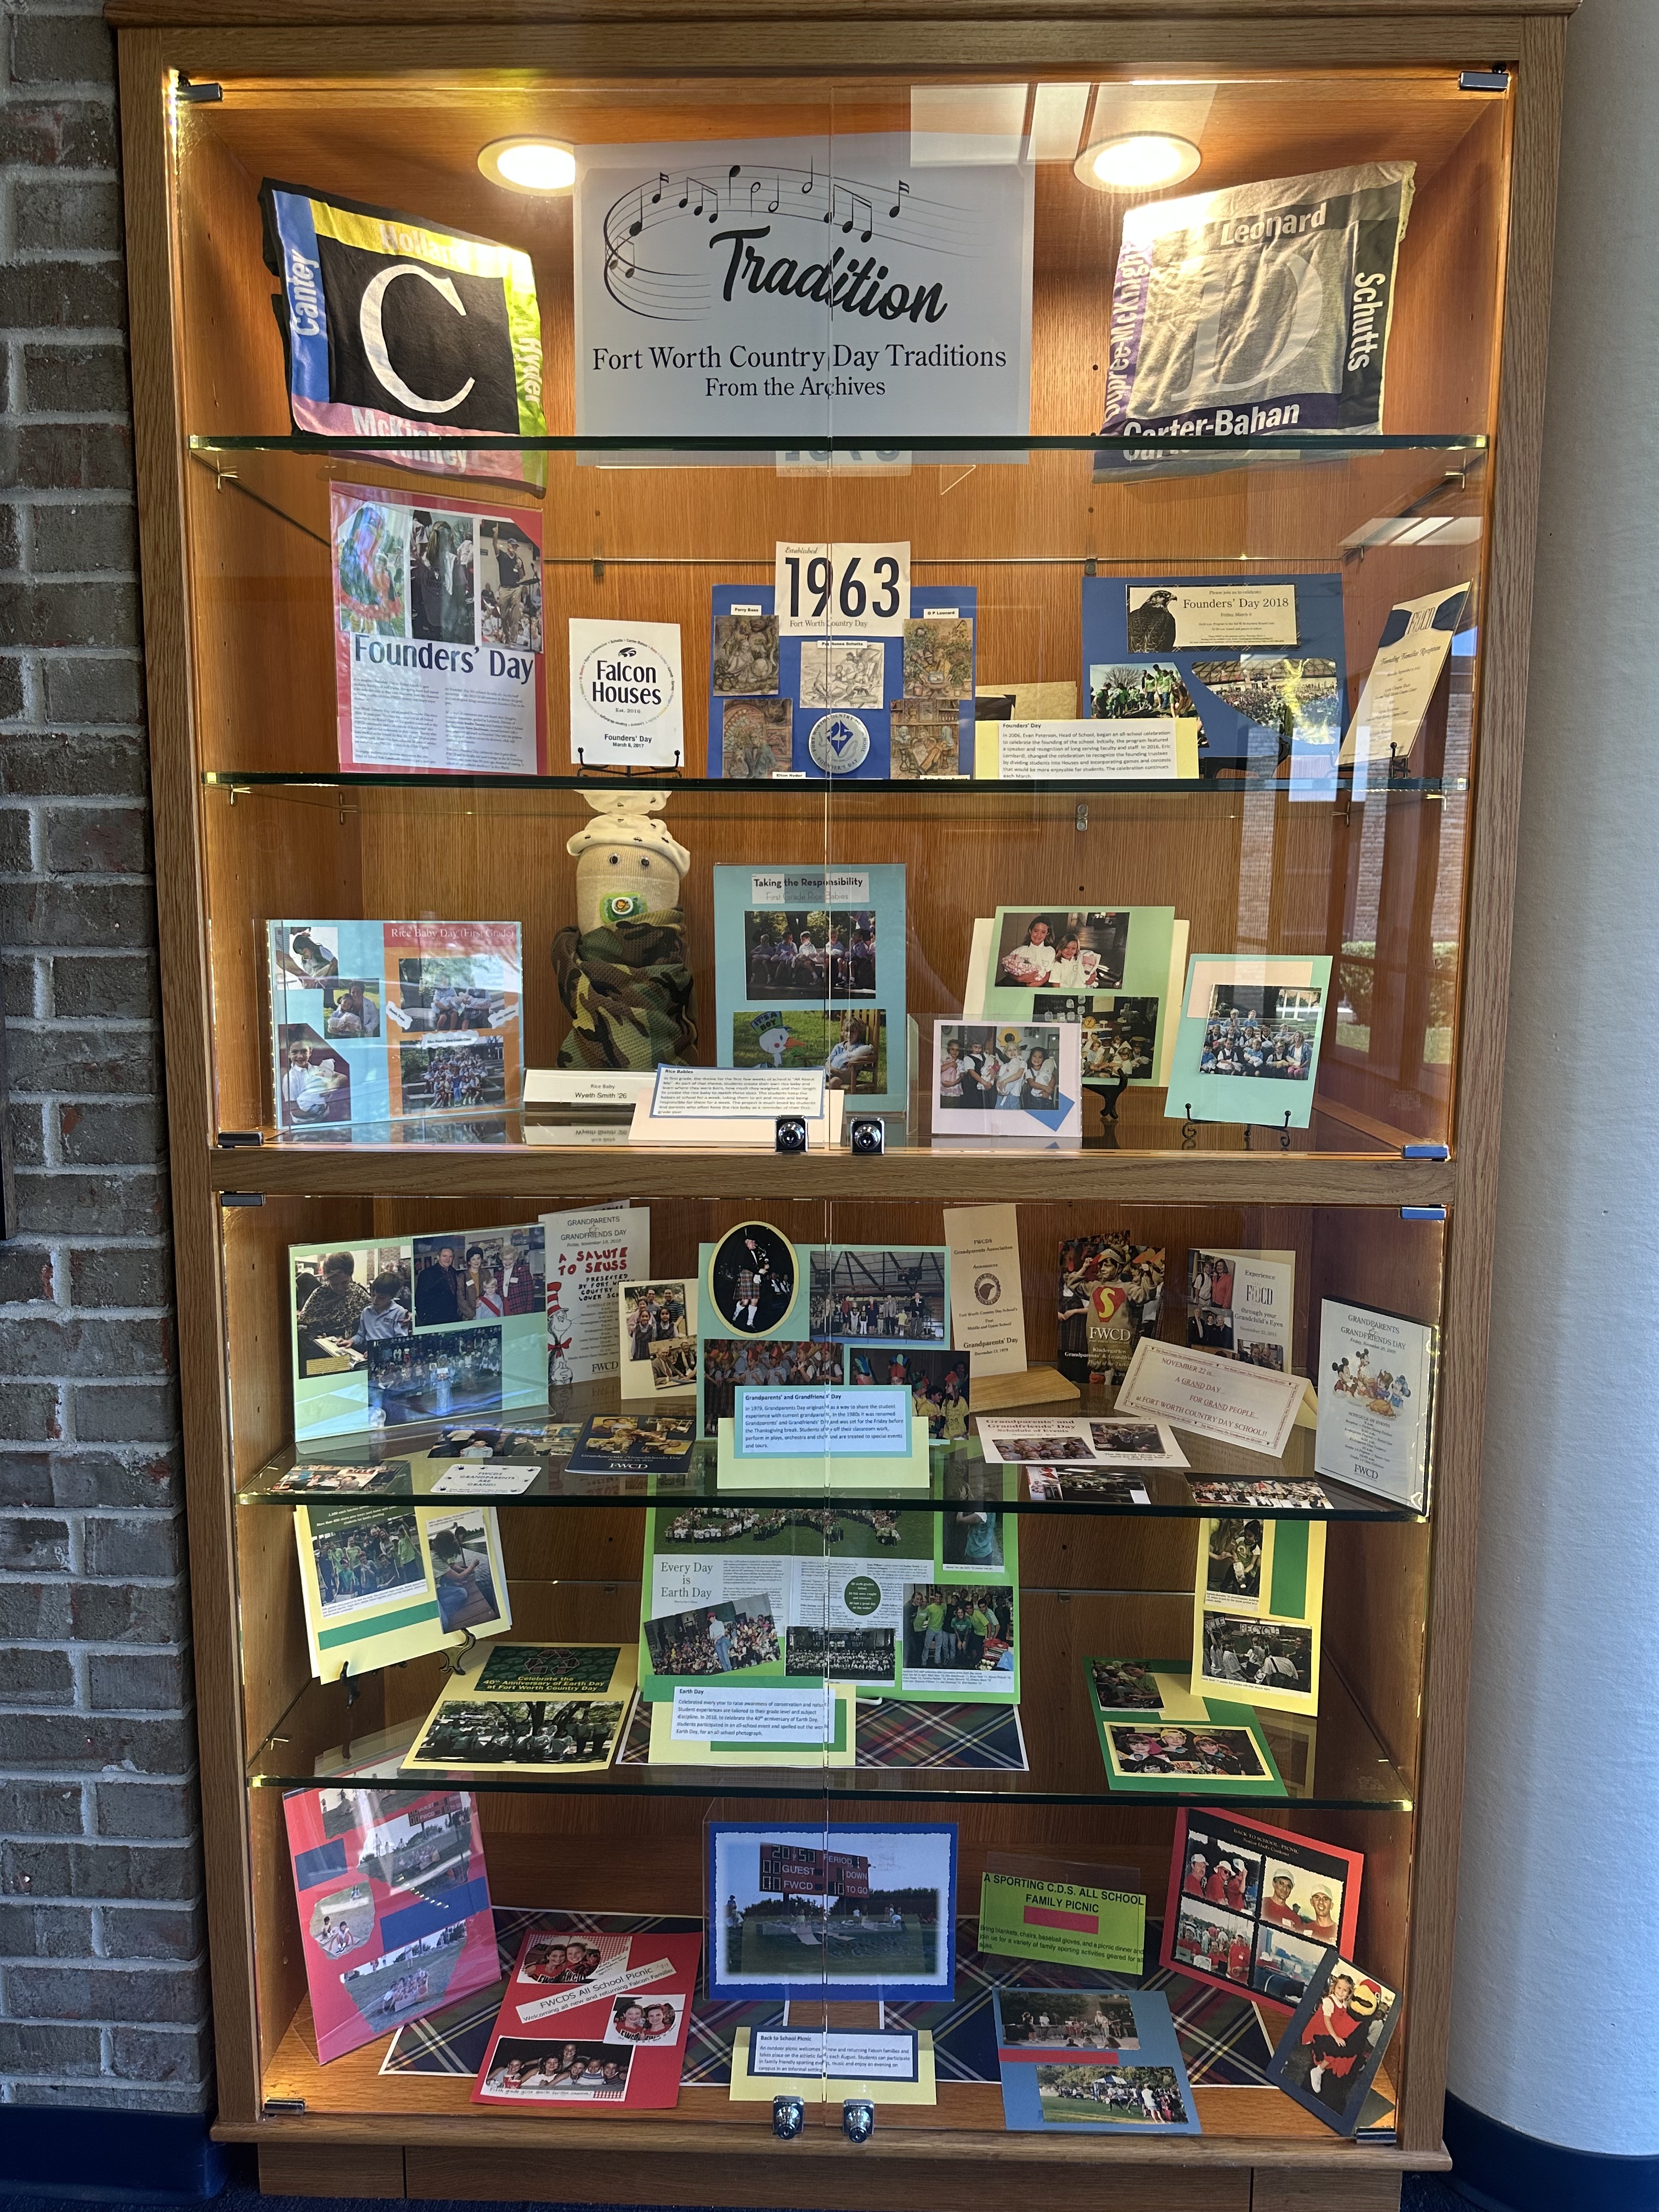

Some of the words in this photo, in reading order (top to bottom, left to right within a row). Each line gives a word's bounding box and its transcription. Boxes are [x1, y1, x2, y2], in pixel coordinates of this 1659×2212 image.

[1220, 203, 1327, 246] Leonard
[709, 225, 947, 323] Tradition
[292, 249, 319, 336] Cantey
[1347, 272, 1386, 371] Schutts
[360, 264, 475, 413] C
[593, 348, 643, 370] Fort
[648, 345, 721, 369] Worth
[730, 345, 826, 371] Country
[833, 345, 880, 371] Day
[885, 343, 1006, 367] Traditions
[706, 377, 758, 396] From
[764, 377, 794, 396] the
[799, 376, 885, 396] Archives
[1123, 403, 1300, 437] Carter-Bahan
[785, 556, 900, 617] 1963
[1183, 599, 1235, 608] Founders'
[1239, 599, 1260, 609] Day
[1263, 598, 1289, 607] 2018
[355, 634, 479, 673] Founders'
[490, 650, 533, 685] Day
[597, 660, 656, 683] Falcon
[592, 681, 662, 705] Houses
[754, 879, 782, 888] Taking
[802, 877, 863, 887] Responsibility
[766, 892, 781, 900] First
[783, 891, 805, 900] Grade
[808, 891, 822, 900] Rice
[825, 891, 848, 900] Babies
[391, 929, 411, 938] Rice
[415, 928, 437, 940] Baby
[440, 929, 458, 940] Day
[460, 928, 482, 939] (First
[486, 928, 514, 938] Grade)
[567, 1216, 620, 1226] GRANDPARENTS
[561, 1231, 612, 1240] GRANDFRIENDS
[559, 1254, 567, 1263] A
[576, 1247, 628, 1262] SALUTE
[558, 1264, 577, 1276] TO
[585, 1260, 627, 1273] SEUSS
[1245, 1269, 1275, 1280] Experience
[586, 1273, 628, 1282] PRESENTED
[581, 1287, 612, 1295] COUNTRY
[1348, 1314, 1400, 1334] GRANDPARENTS
[1089, 1327, 1131, 1341] FWCD
[1341, 1327, 1392, 1346] GRANDFRIENDS
[1393, 1340, 1406, 1350] DAY
[963, 1338, 1005, 1348] Grandparents'
[592, 1361, 618, 1372] FWCD
[1161, 1358, 1198, 1373] NOVEMBER
[1181, 1378, 1205, 1390] GRAND
[1189, 1395, 1203, 1404] FOR
[1204, 1399, 1228, 1411] GRAND
[1142, 1397, 1159, 1406] FORT
[1160, 1402, 1184, 1414] WORTH
[1184, 1408, 1217, 1423] COUNTRY
[1218, 1418, 1234, 1428] DAY
[1234, 1423, 1267, 1437] SCHOOL!!
[1355, 1464, 1378, 1479] FWCD
[661, 1562, 690, 1573] Every
[693, 1562, 713, 1573] Day
[682, 1575, 691, 1584] is
[661, 1588, 688, 1598] Earth
[692, 1588, 712, 1599] Day
[824, 1854, 852, 1865] PERIOD
[782, 1865, 815, 1875] GUEST
[847, 1871, 867, 1880] DOWN
[784, 1881, 813, 1890] FWCD
[994, 1875, 1044, 1890] SPORTING
[1047, 1883, 1076, 1895] C.D.S.
[1079, 1888, 1098, 1899] ALL
[1101, 1892, 1144, 1905] SCHOOL
[1026, 1894, 1063, 1908] FAMILY
[1065, 1900, 1099, 1912] PICNIC
[540, 1994, 577, 2008] FWCDS
[579, 1986, 591, 1996] All
[592, 1975, 624, 1991] School
[626, 1966, 653, 1981] Picnic
